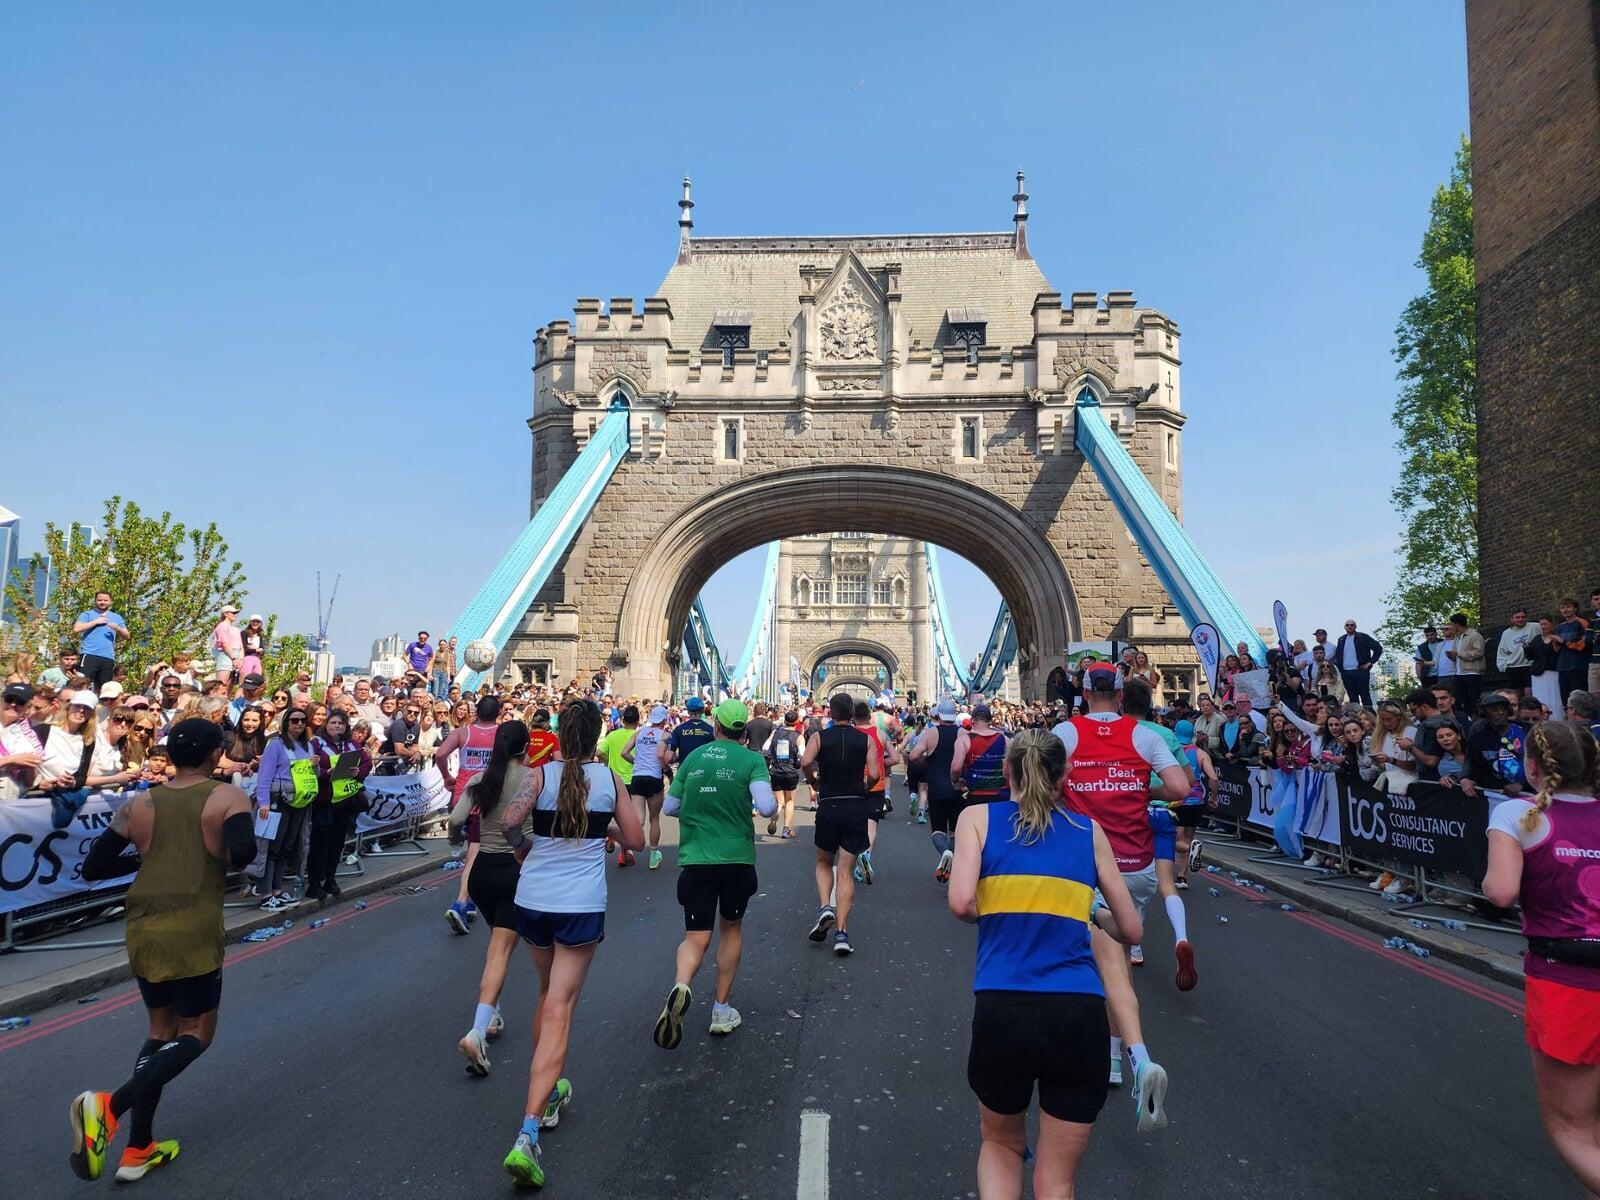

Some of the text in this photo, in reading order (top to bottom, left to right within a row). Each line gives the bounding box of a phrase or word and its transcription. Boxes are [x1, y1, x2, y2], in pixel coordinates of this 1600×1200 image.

[1108, 767, 1136, 778] Beat
[1068, 778, 1146, 792] heartbreak.
[1255, 773, 1275, 816] tc
[1387, 793, 1416, 811] TATA
[77, 811, 114, 830] TAT
[1347, 785, 1388, 843] tcs
[1389, 812, 1466, 838] CONSULTANCY
[1391, 832, 1435, 854] SERVICES
